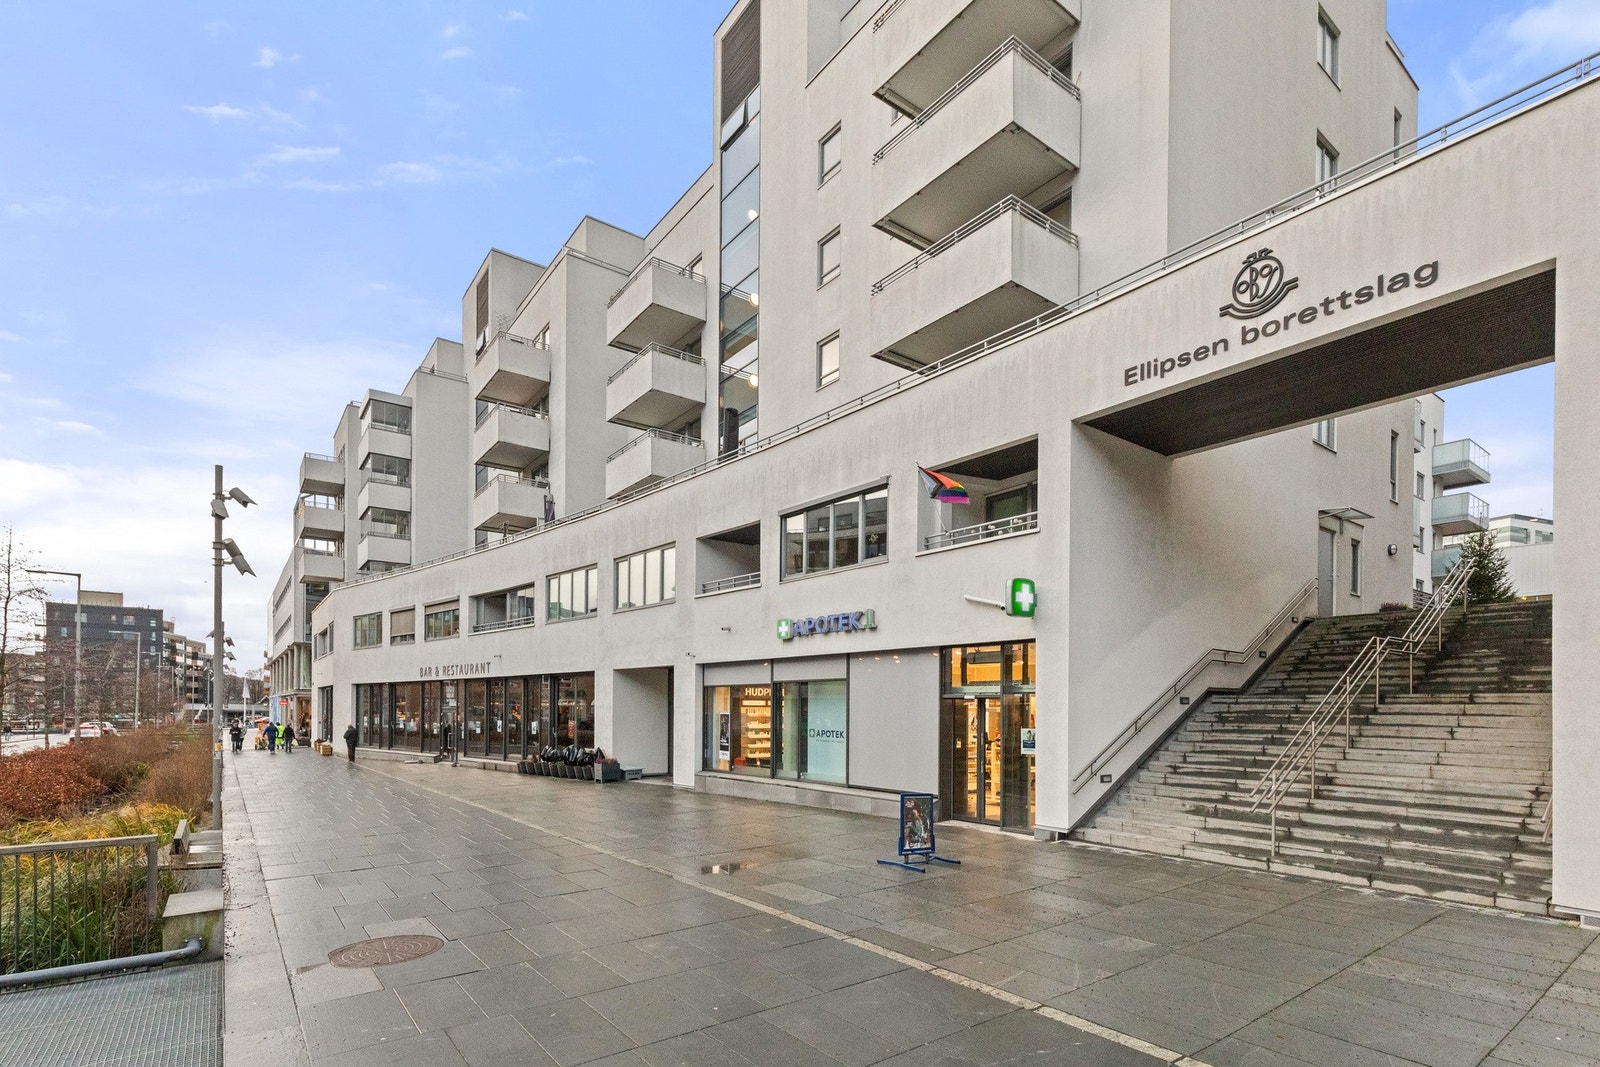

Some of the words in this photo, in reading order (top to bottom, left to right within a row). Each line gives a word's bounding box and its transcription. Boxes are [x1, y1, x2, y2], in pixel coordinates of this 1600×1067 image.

[1124, 338, 1229, 387] Ellipsen
[1241, 260, 1439, 346] borettslag
[420, 666, 433, 678] BAR
[442, 661, 491, 677] RESTAURANT
[816, 729, 845, 739] APOTEK
